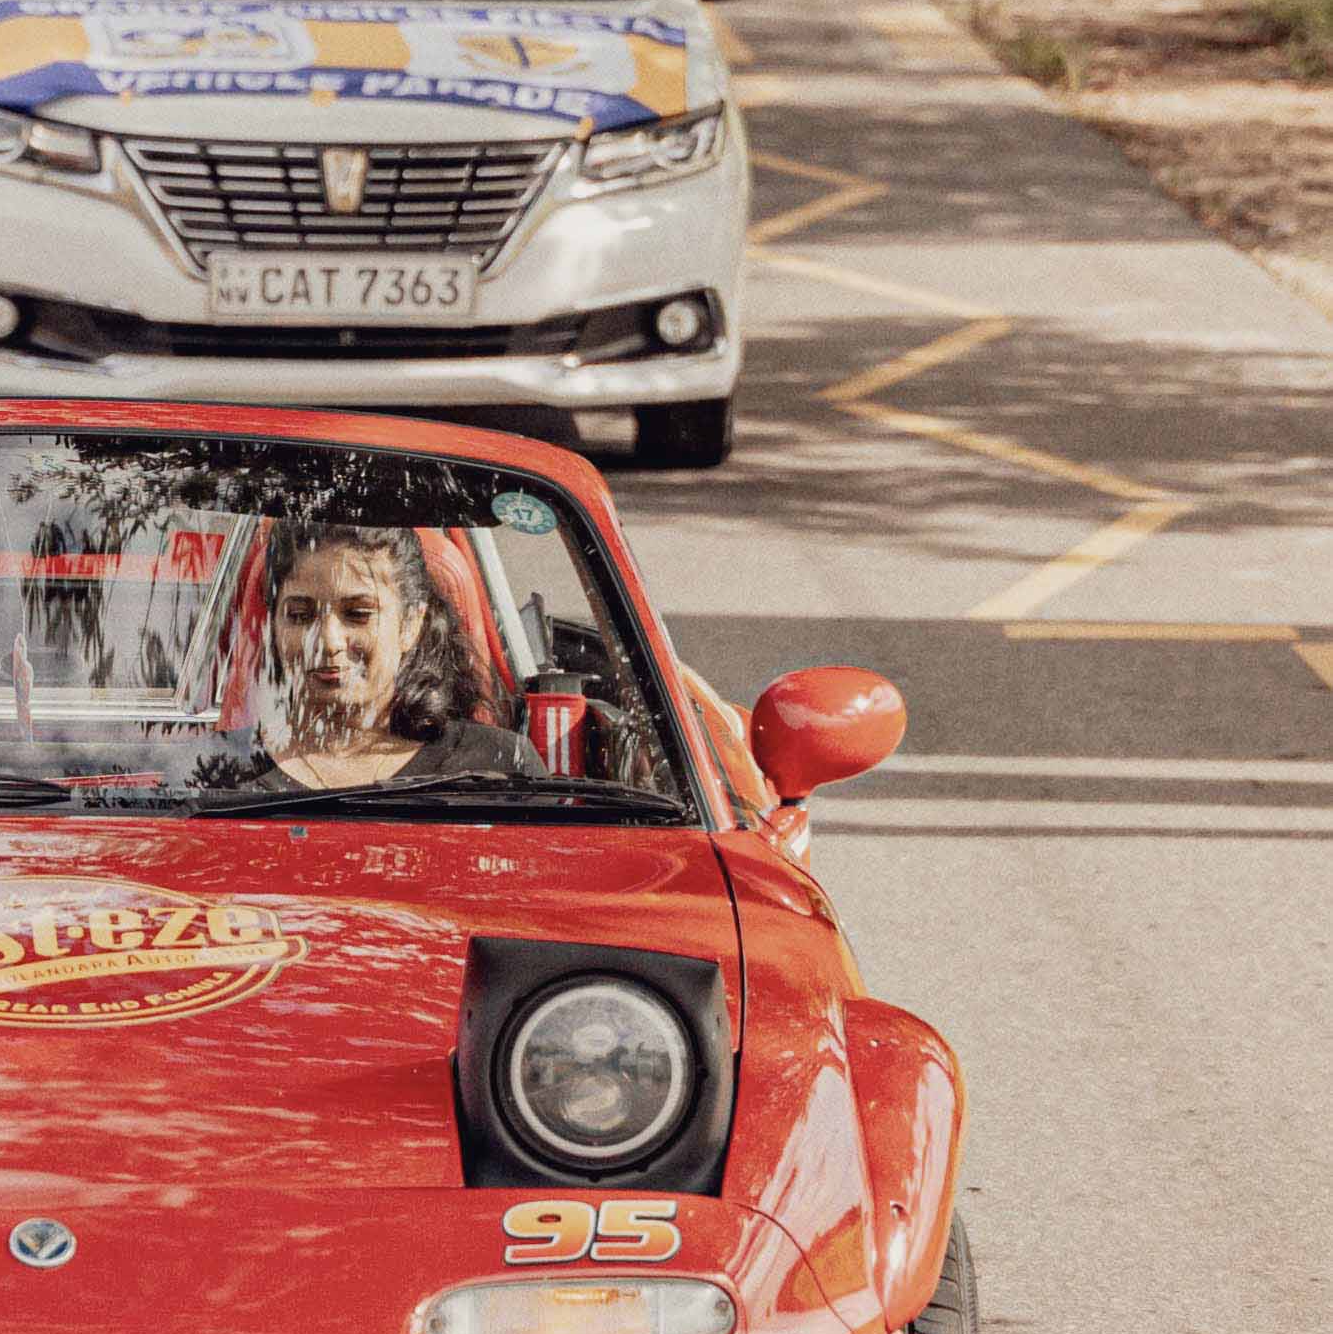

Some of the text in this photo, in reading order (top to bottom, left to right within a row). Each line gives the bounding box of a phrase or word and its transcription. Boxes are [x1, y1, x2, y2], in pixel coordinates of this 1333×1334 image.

[95, 68, 592, 122] VEHICLE PARADE
[260, 268, 340, 305] CAT
[357, 268, 460, 306] 7363
[79, 999, 141, 1015] END
[503, 1199, 682, 1264] 95
